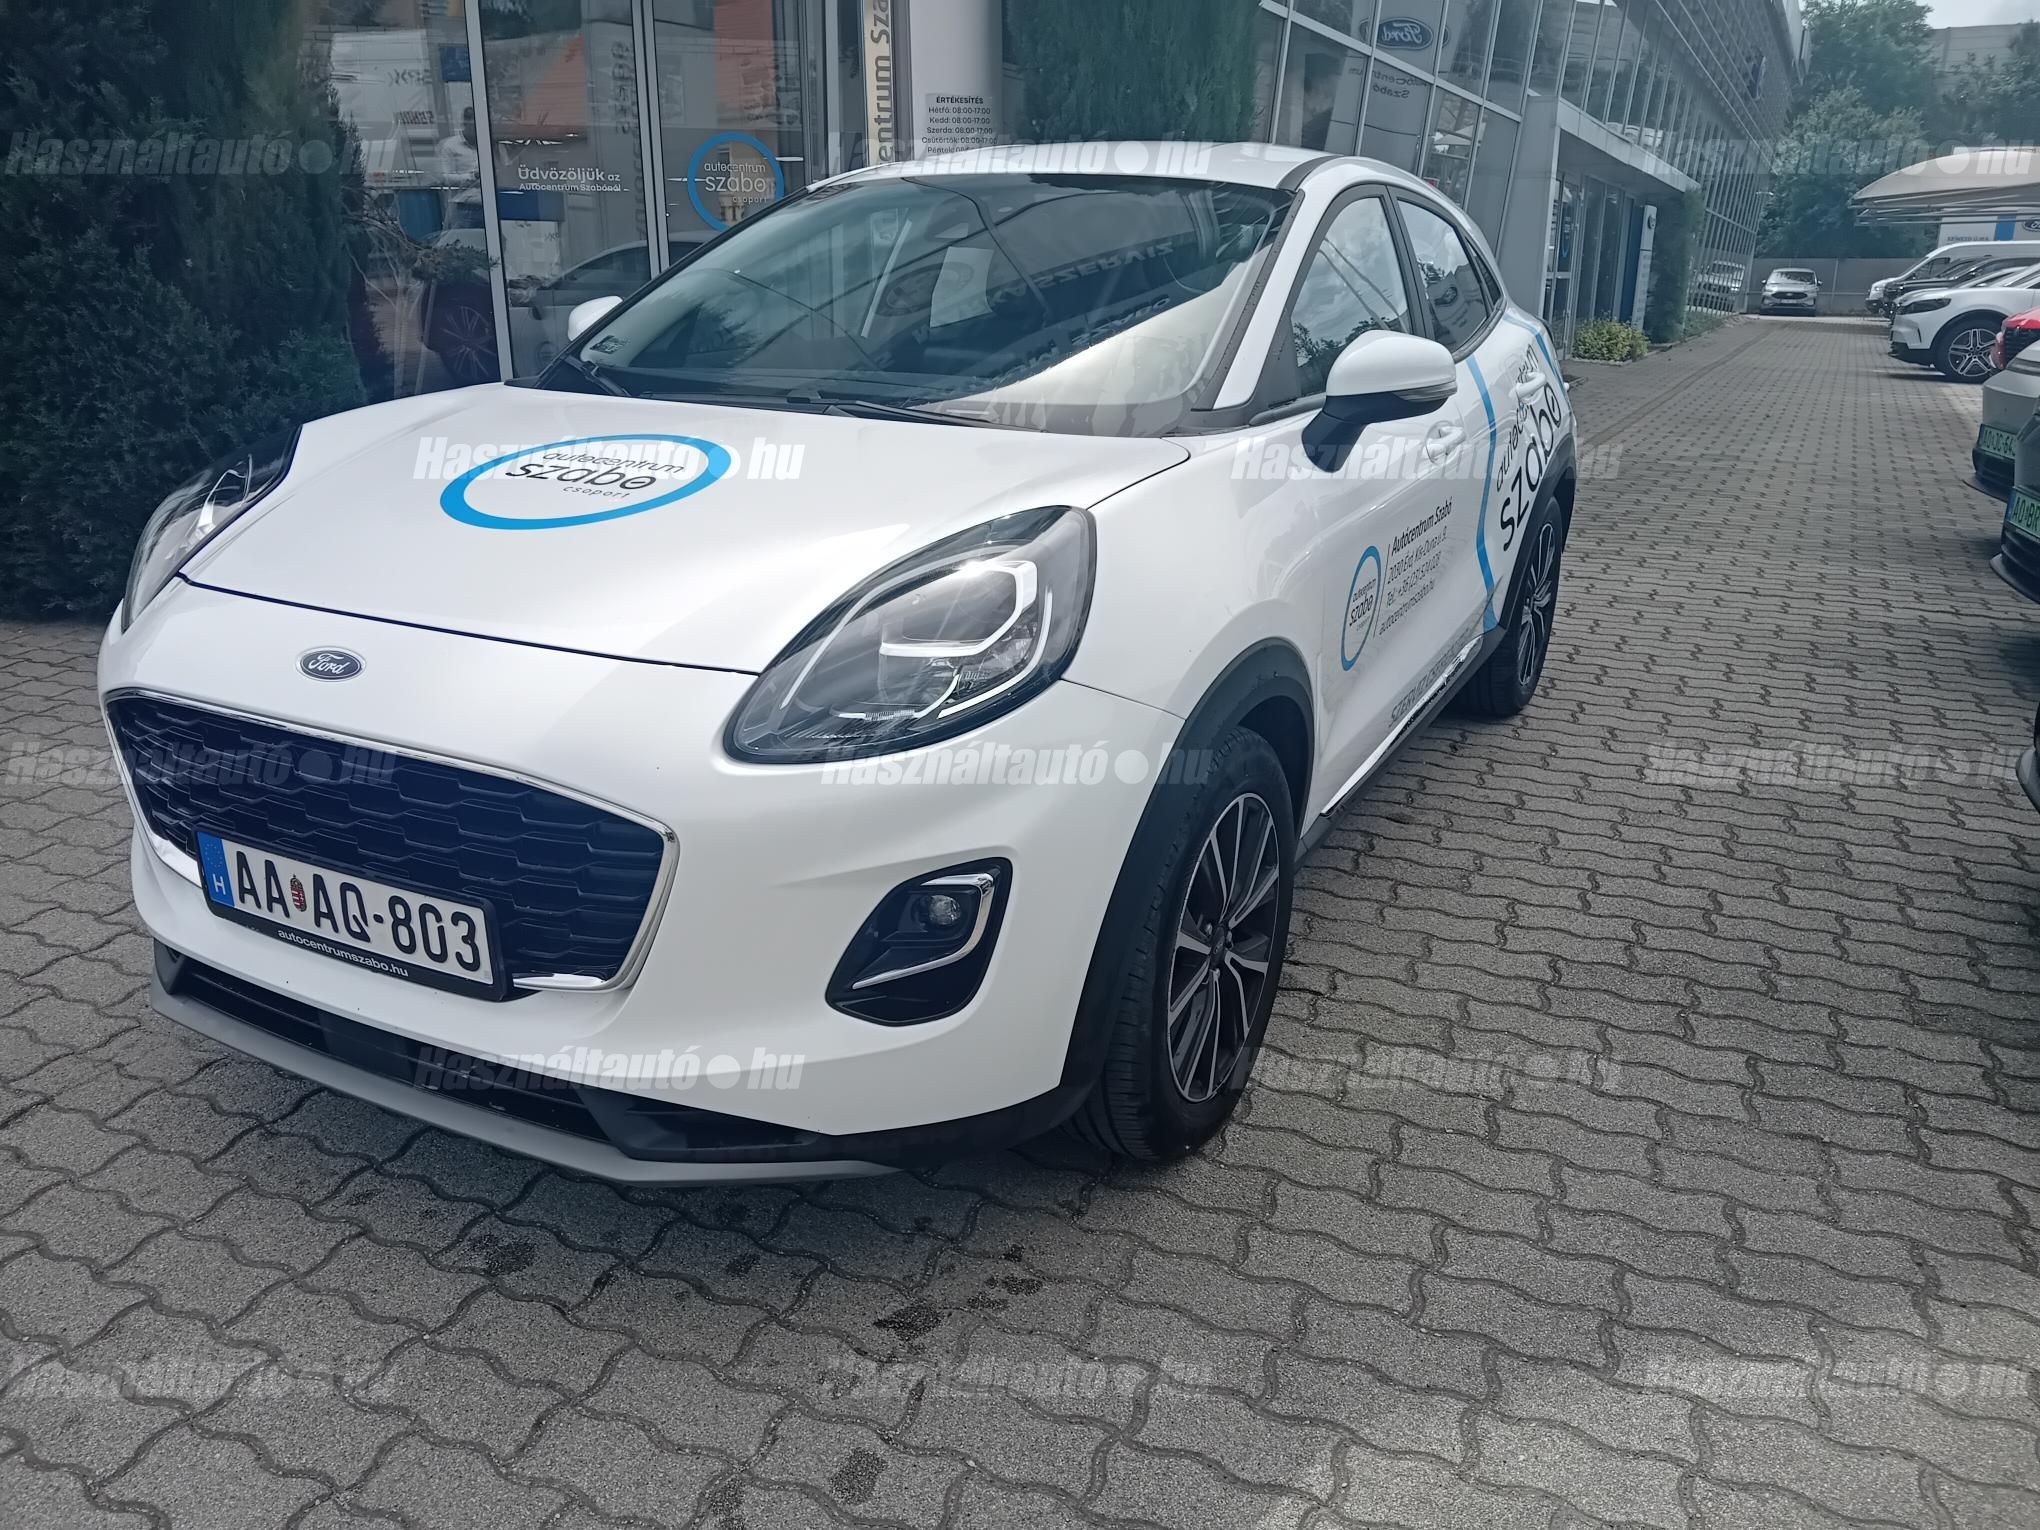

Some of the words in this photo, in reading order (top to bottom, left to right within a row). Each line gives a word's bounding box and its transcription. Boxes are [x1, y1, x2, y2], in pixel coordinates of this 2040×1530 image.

[518, 164, 605, 183] Üdvözöljük
[607, 173, 621, 182] az
[563, 485, 631, 499] csoport
[308, 652, 351, 674] Ford
[213, 874, 226, 896] H
[277, 928, 409, 977] autocentrumszabo.hu
